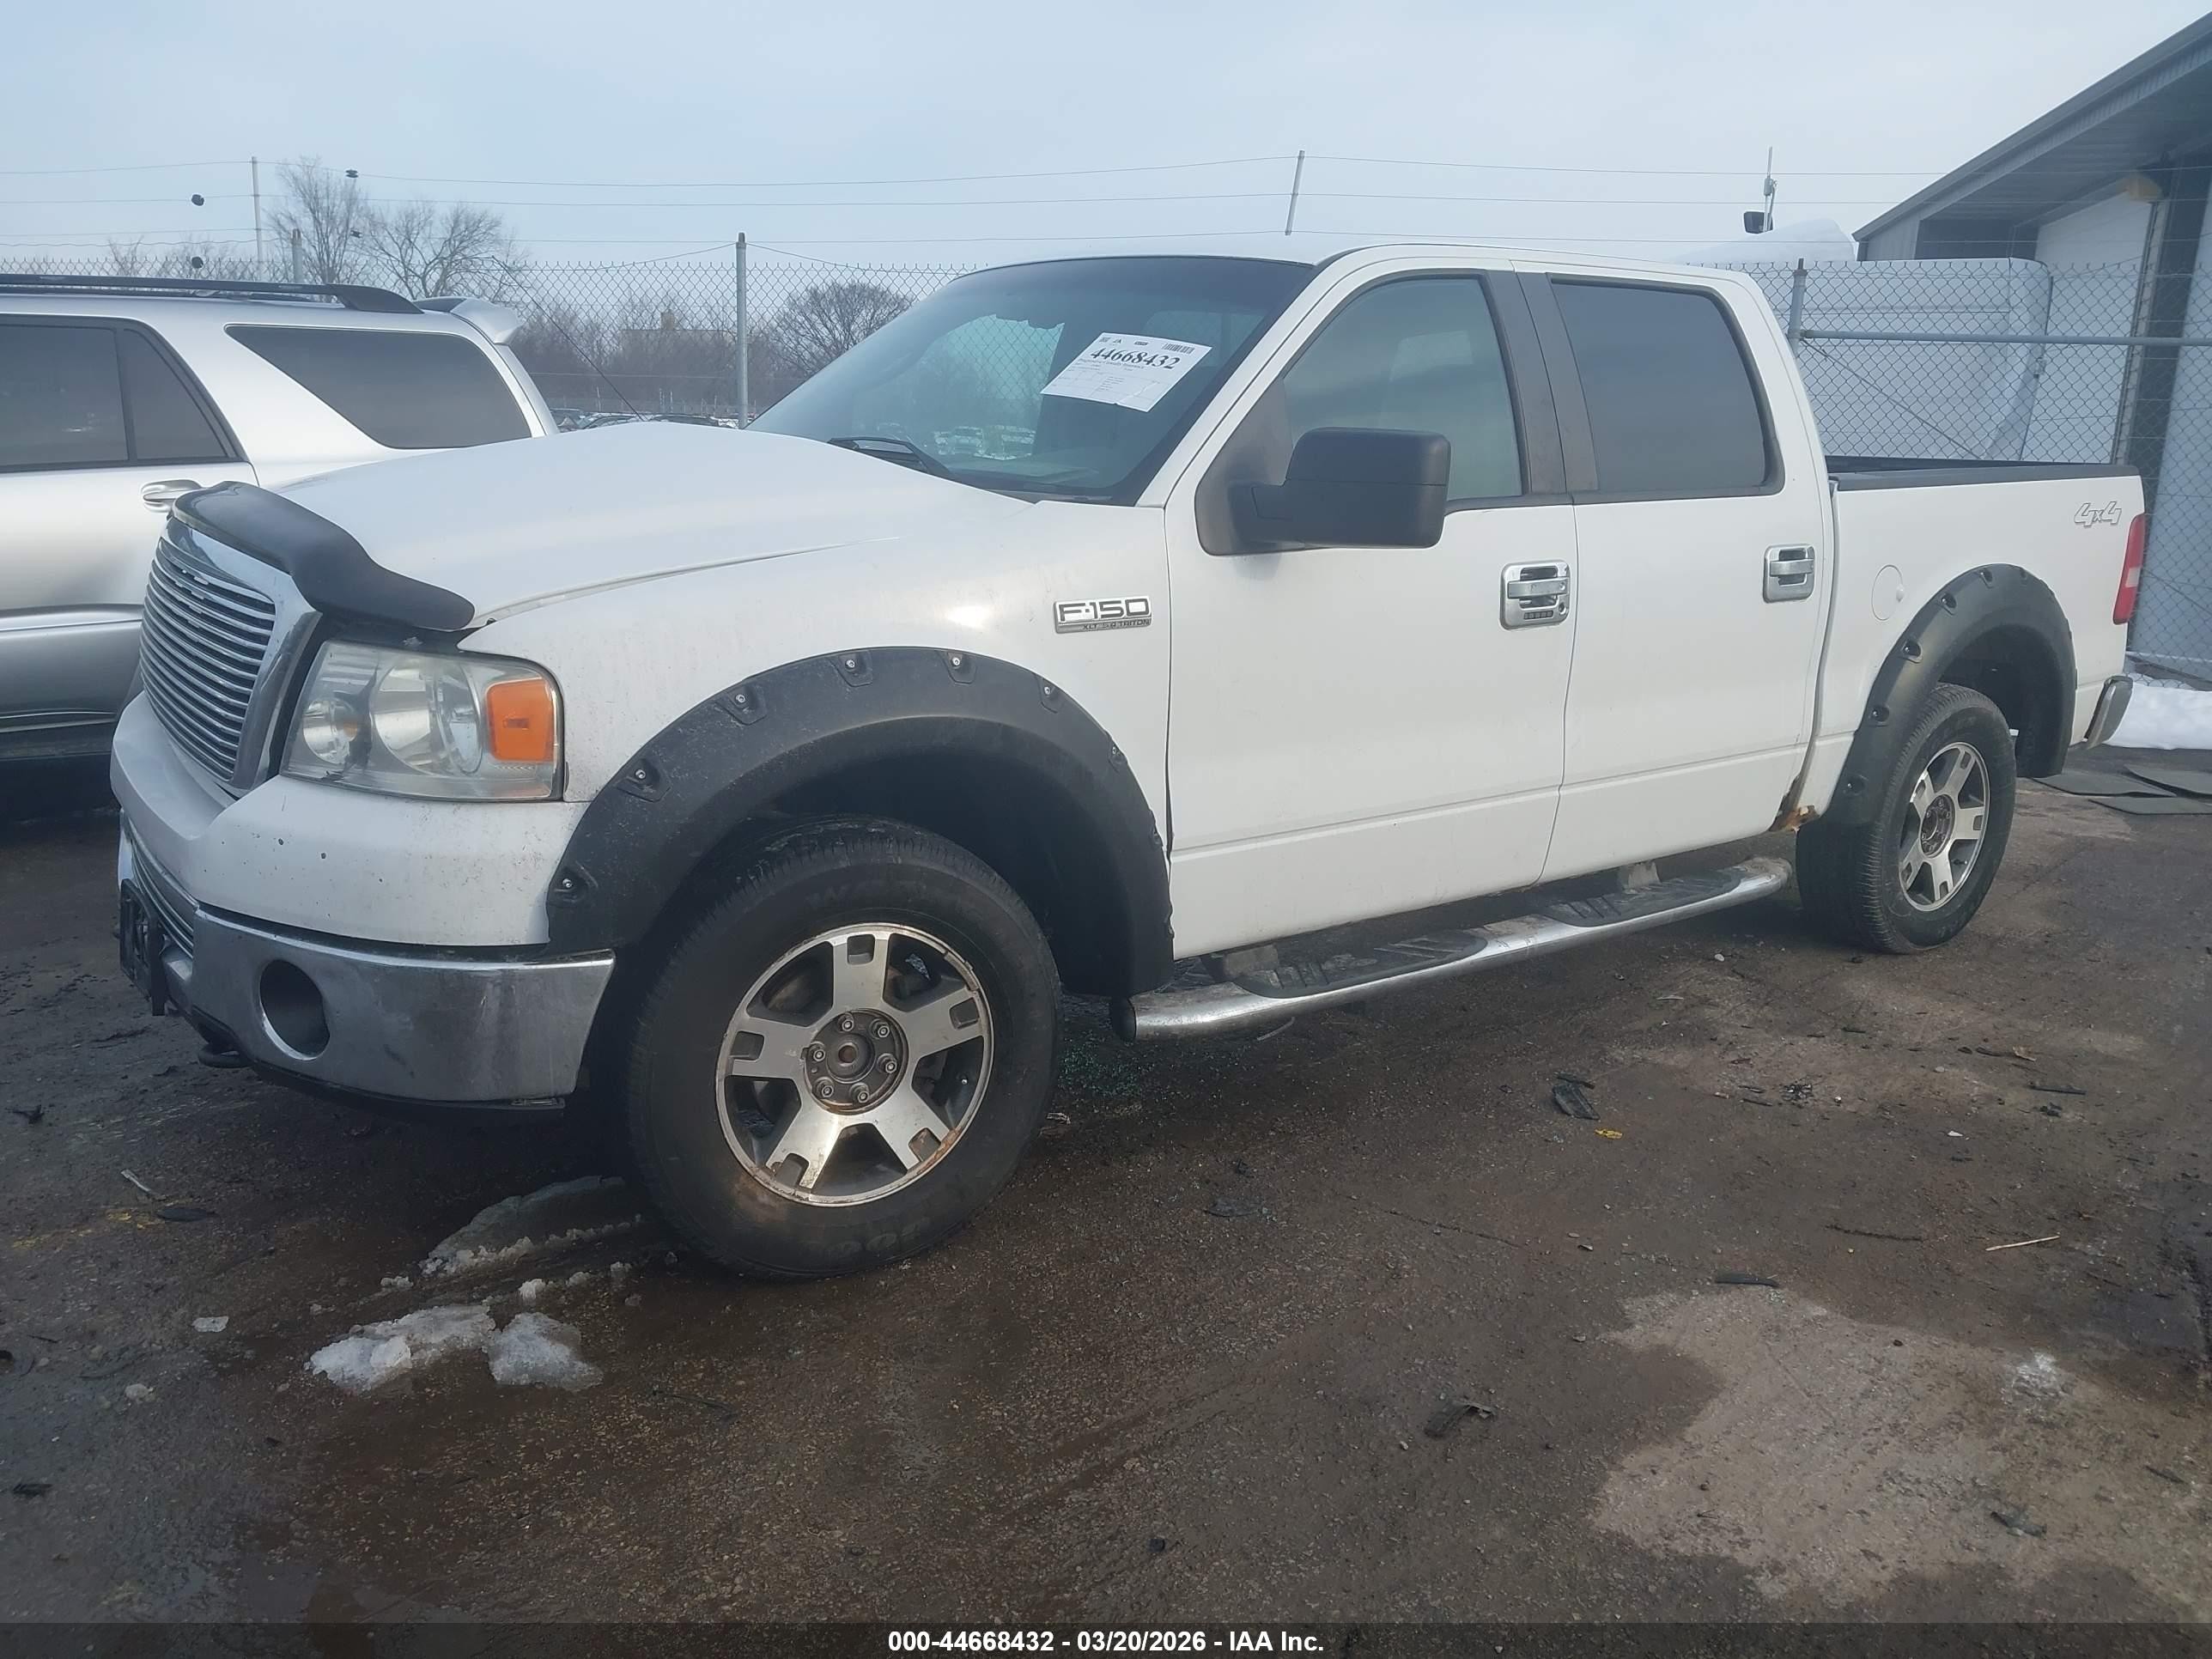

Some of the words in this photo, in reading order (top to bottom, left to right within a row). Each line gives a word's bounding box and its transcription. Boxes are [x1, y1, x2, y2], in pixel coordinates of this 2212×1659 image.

[1091, 347, 1181, 369] 44668432
[2074, 501, 2122, 527] 4x4
[1058, 598, 1151, 622] F-150
